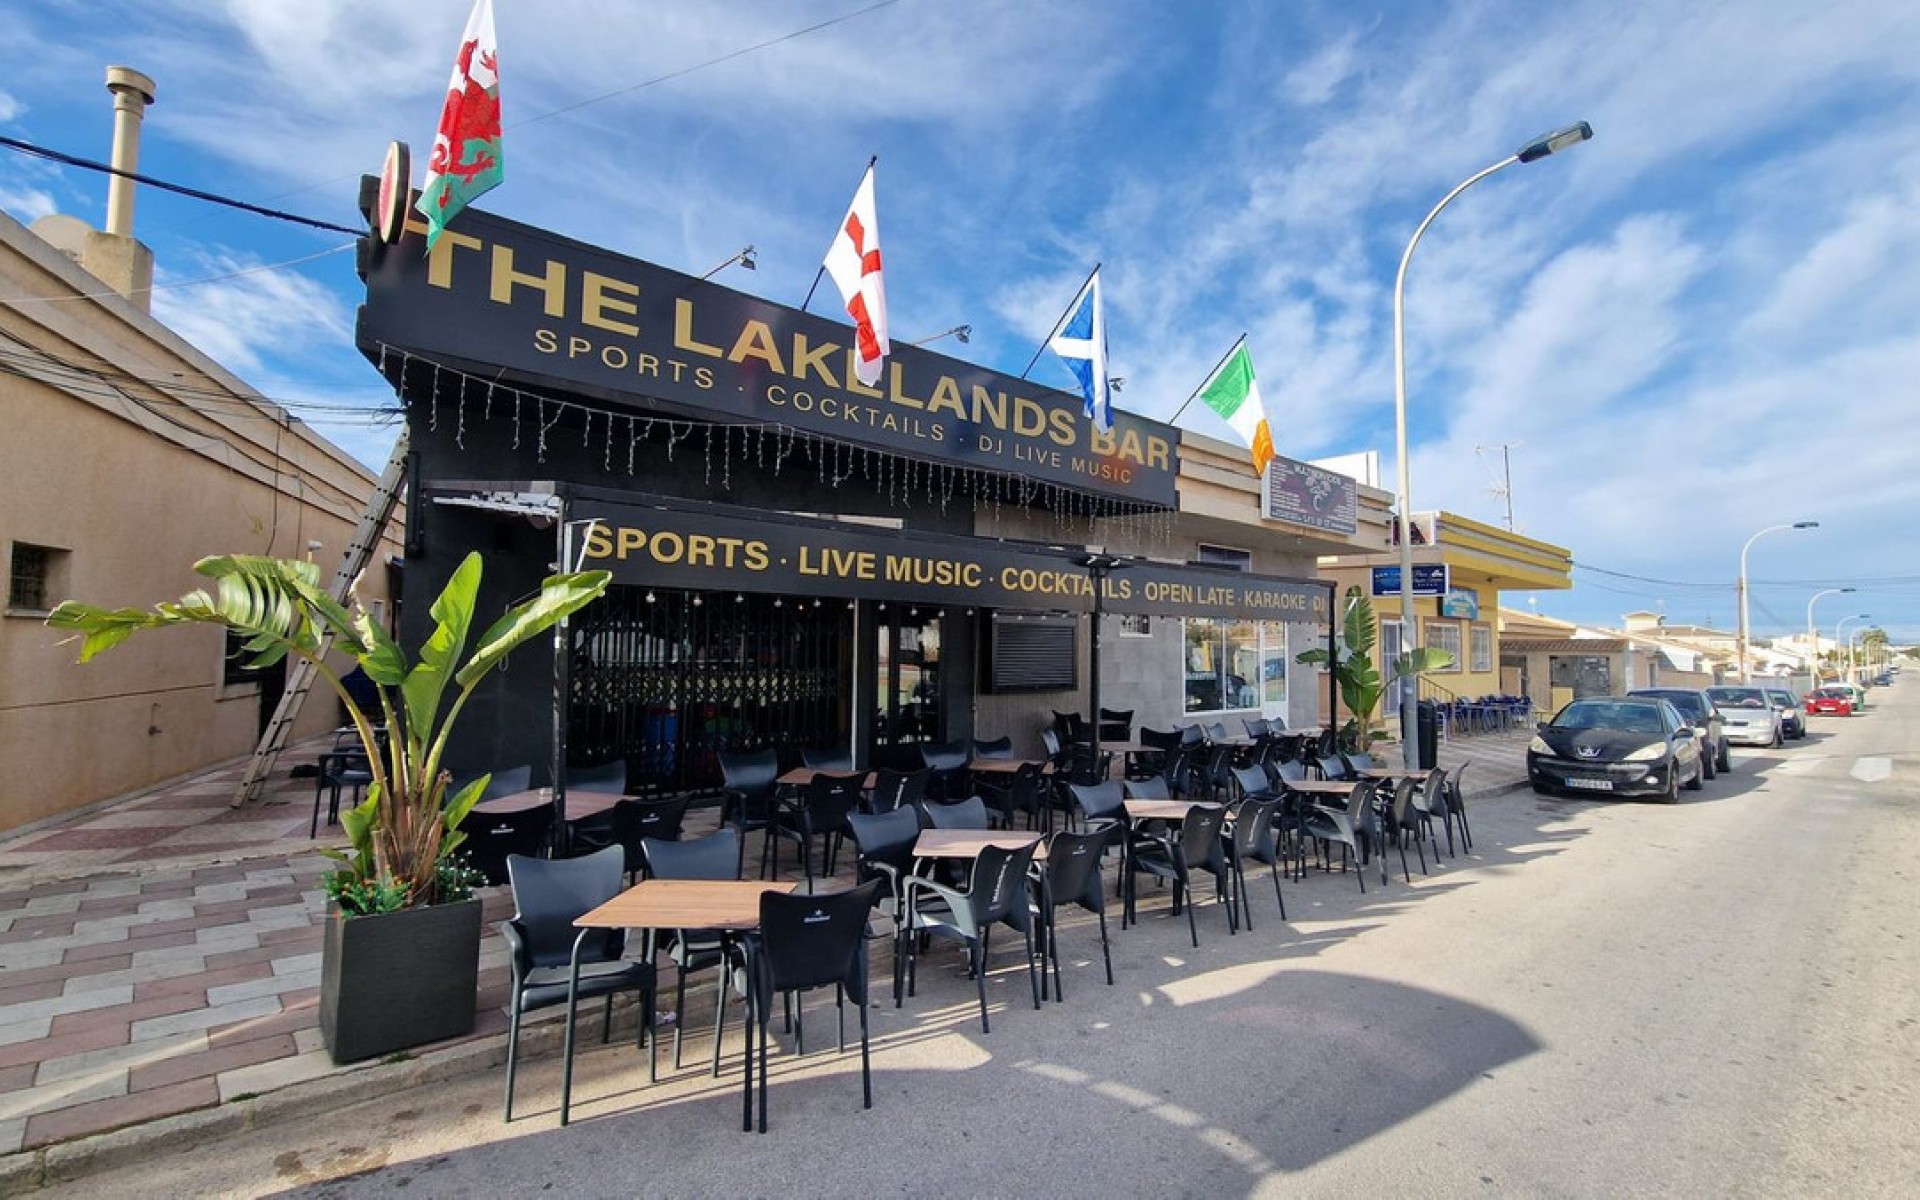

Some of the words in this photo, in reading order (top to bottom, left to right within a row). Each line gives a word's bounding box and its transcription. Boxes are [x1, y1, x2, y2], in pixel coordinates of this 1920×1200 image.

[405, 218, 640, 337] THE
[1091, 419, 1169, 472] BAR
[534, 329, 714, 389] SPORTS
[767, 385, 944, 441] COCKTAILS
[978, 435, 1003, 455] DJ
[1014, 443, 1061, 468] LIVE
[1072, 457, 1132, 485] MUSIC
[582, 523, 770, 571] SPORTS
[799, 546, 876, 580] LIVE
[885, 555, 982, 588] MUSIC
[1001, 567, 1132, 600] COCKTAILS
[1145, 581, 1193, 604] OPEN
[1197, 585, 1234, 606] LATE
[1243, 589, 1306, 611] KARAOKE
